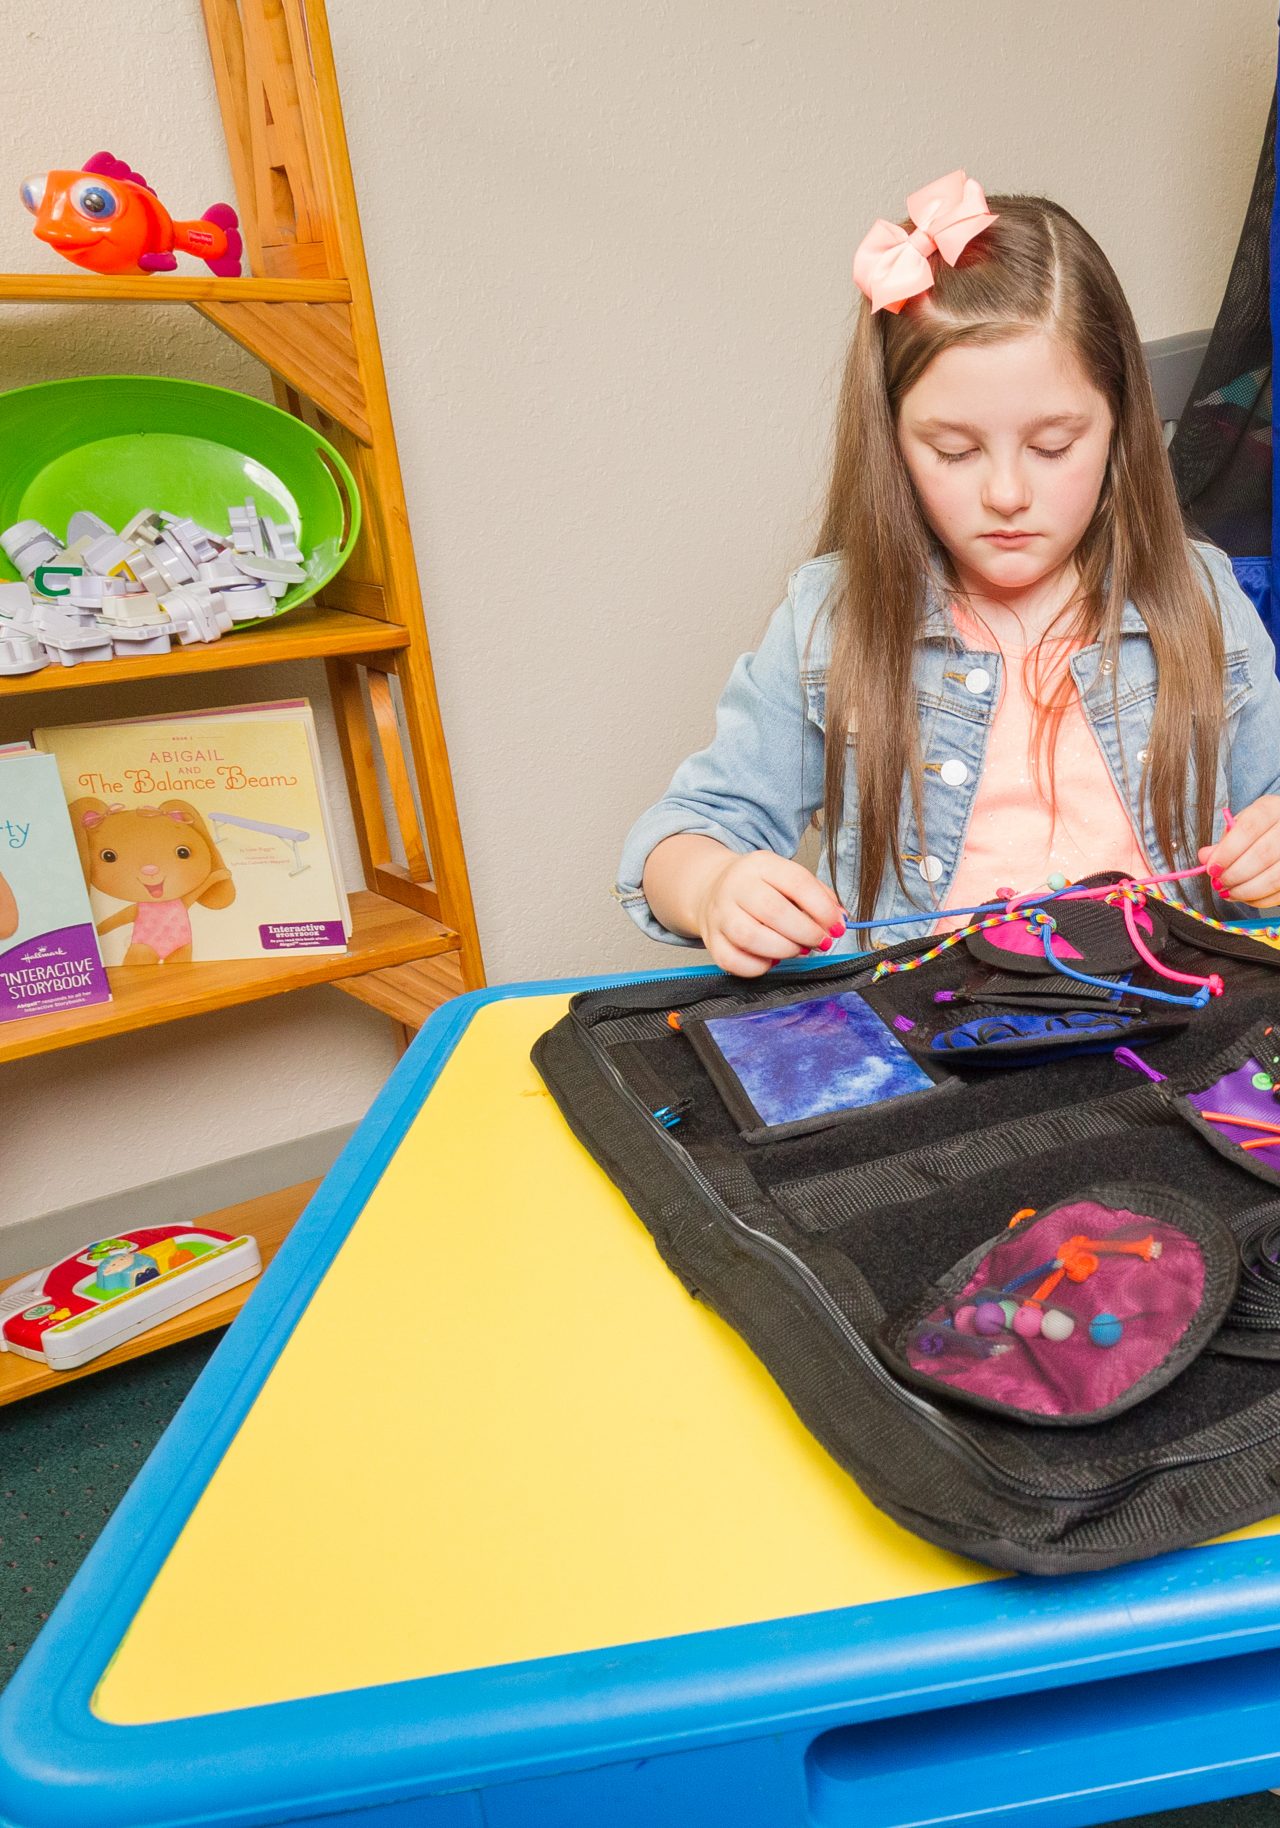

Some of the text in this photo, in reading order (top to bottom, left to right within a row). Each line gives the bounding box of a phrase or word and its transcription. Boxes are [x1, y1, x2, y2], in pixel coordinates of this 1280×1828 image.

[150, 749, 225, 763] ABIGAIL
[78, 765, 298, 794] The Balance Beam
[178, 766, 201, 775] AND
[0, 819, 30, 848] ty
[267, 923, 326, 934] Interactive
[21, 947, 68, 964] Hallmark
[0, 957, 94, 986] INTERACTIVE
[9, 972, 92, 1000] STORYBOOK
